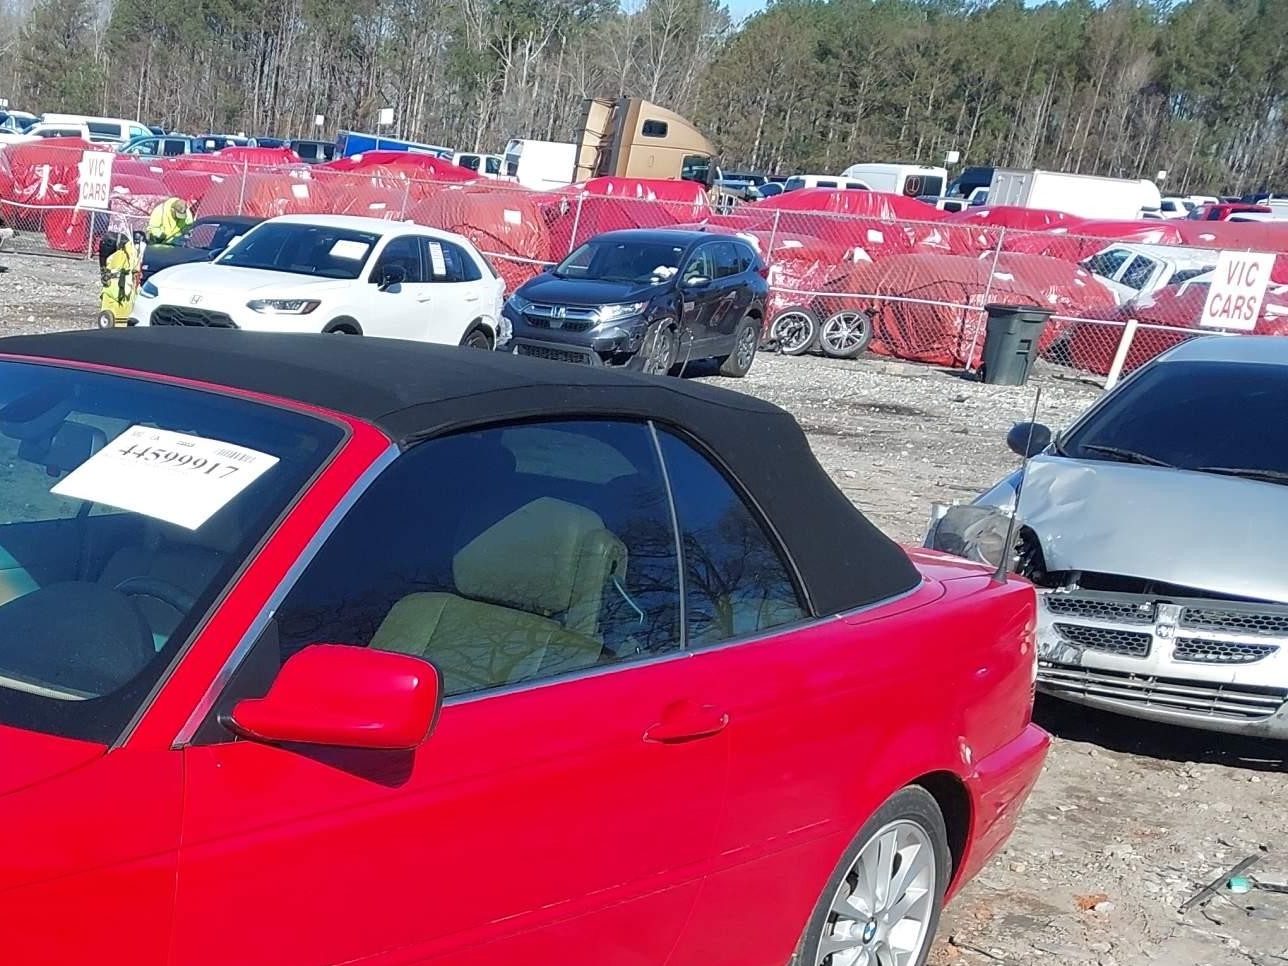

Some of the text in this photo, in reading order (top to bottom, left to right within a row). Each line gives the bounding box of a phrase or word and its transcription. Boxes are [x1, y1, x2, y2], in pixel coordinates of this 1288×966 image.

[88, 158, 105, 177] VIC
[82, 181, 107, 201] CARS
[1226, 259, 1260, 288] VIC
[1209, 293, 1257, 321] CARS
[118, 443, 240, 479] 44599917
